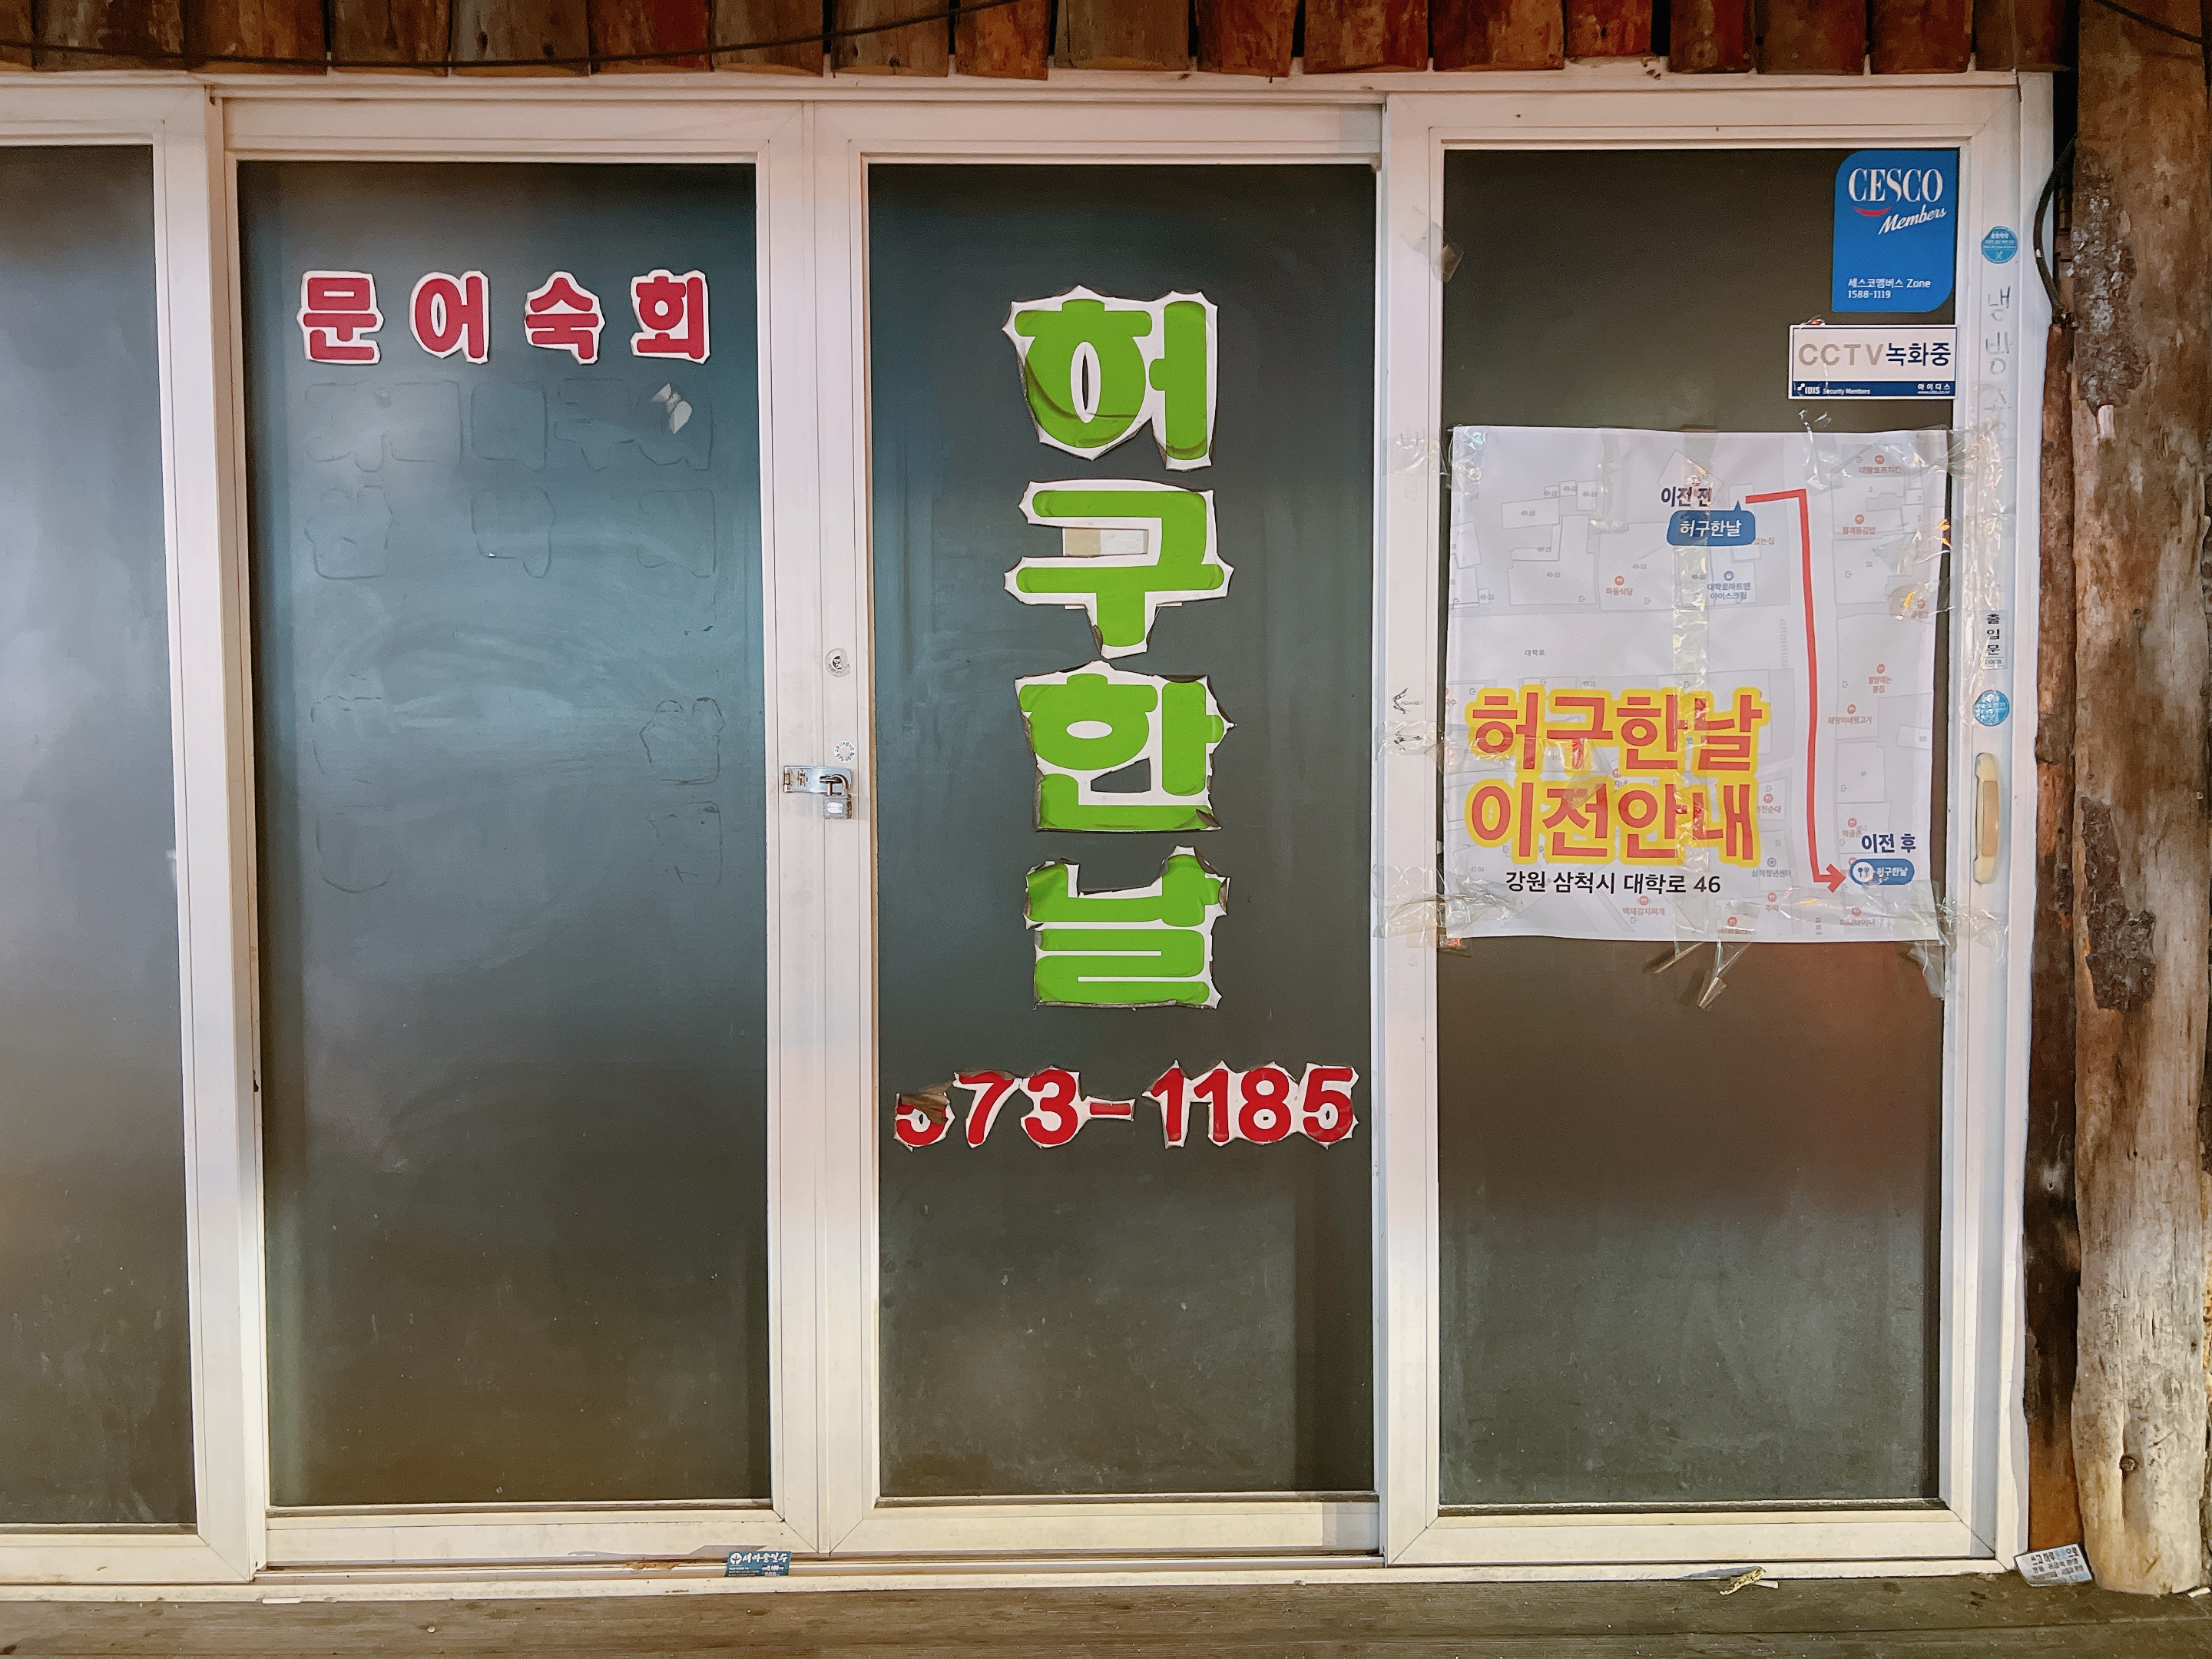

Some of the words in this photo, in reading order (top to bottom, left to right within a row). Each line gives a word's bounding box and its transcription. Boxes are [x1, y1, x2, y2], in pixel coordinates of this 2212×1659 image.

[1848, 168, 1943, 202] CESCO
[1878, 204, 1947, 234] Members
[1848, 278, 1903, 289] 세스코멤버스
[1906, 278, 1932, 289] Zone
[1848, 290, 1892, 299] 1588-1119
[1804, 386, 1821, 395] IDIS
[1661, 486, 1693, 508] 이전
[1697, 487, 1713, 508] 전
[1680, 519, 1742, 537] 허구한날
[1986, 614, 2001, 655] 출입문
[1015, 300, 1225, 1004] 허구한날
[1472, 691, 1763, 771] 허구한날
[1471, 780, 1753, 860] 이전안내
[1862, 833, 1895, 853] 이전
[1901, 833, 1916, 853] 후
[1505, 870, 1546, 892] 강원
[1553, 871, 1615, 895] 삼척시
[1624, 873, 1687, 895] 대학로
[1693, 876, 1721, 893] 46
